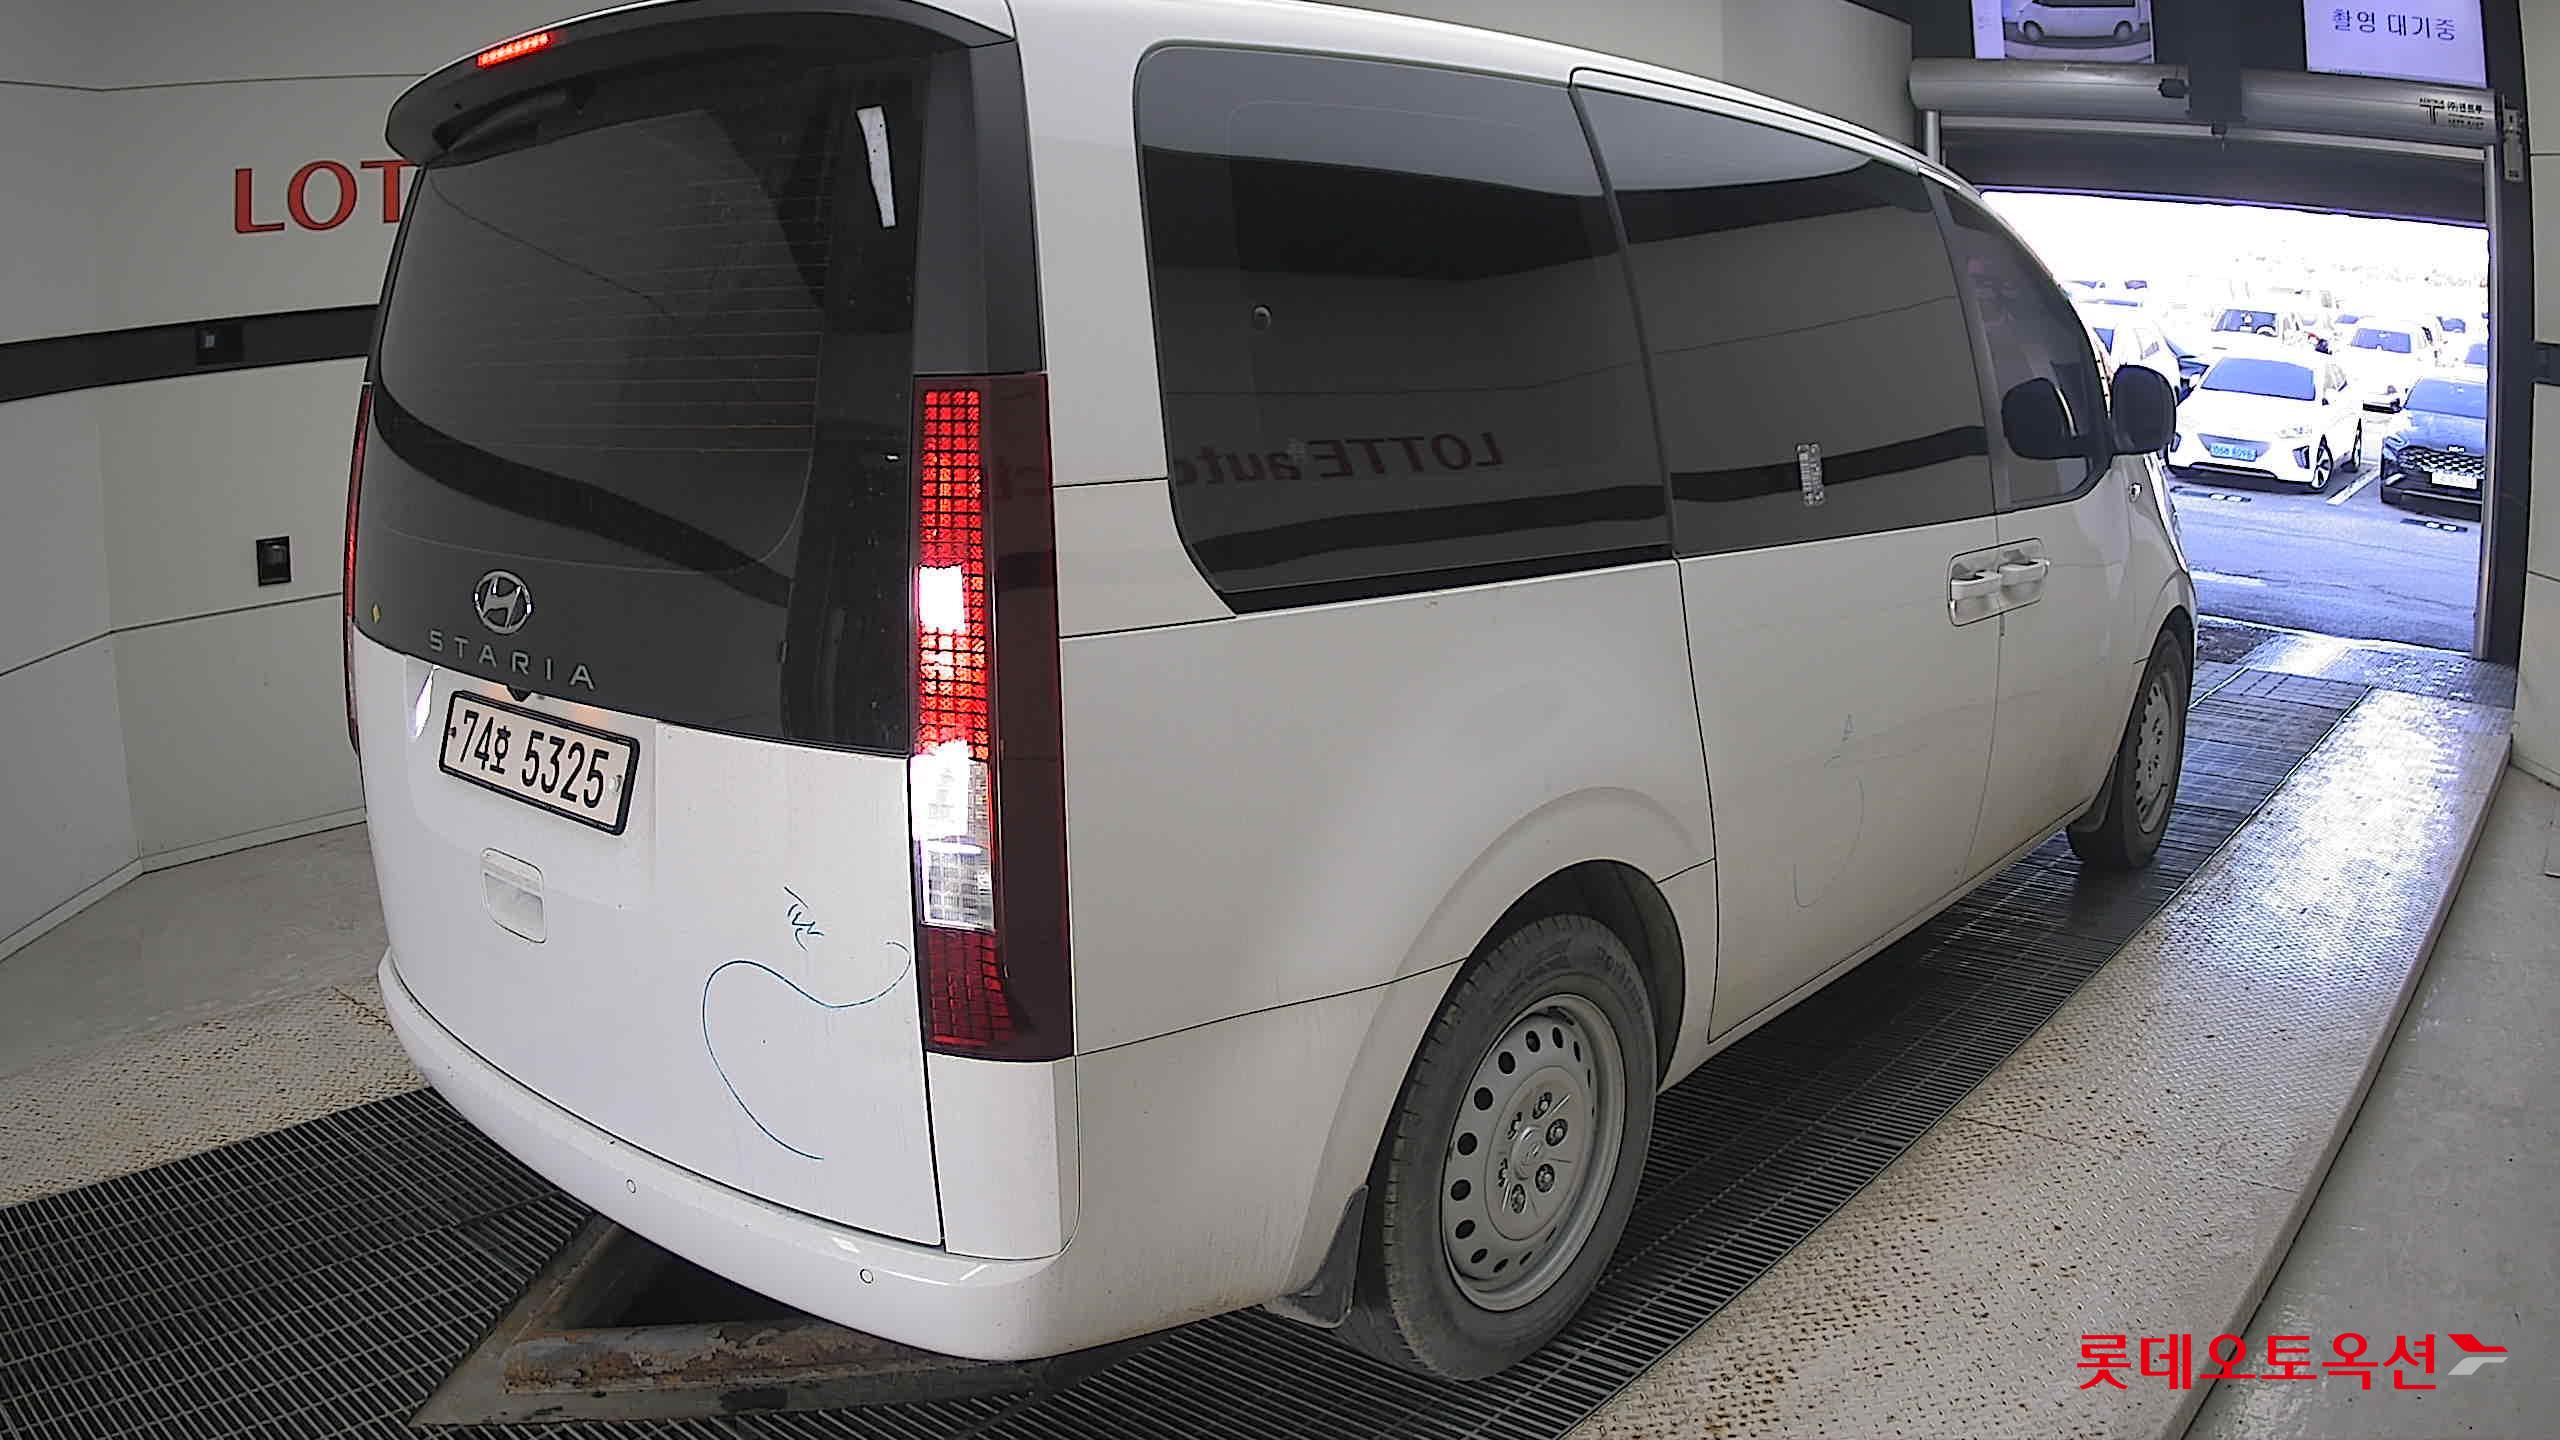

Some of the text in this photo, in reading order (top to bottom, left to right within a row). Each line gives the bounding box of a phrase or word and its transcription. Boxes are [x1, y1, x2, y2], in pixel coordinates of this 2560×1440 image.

[2332, 8, 2457, 41] 촬영 대기중
[429, 630, 595, 690] STARIA
[459, 709, 609, 808] 74호 5325
